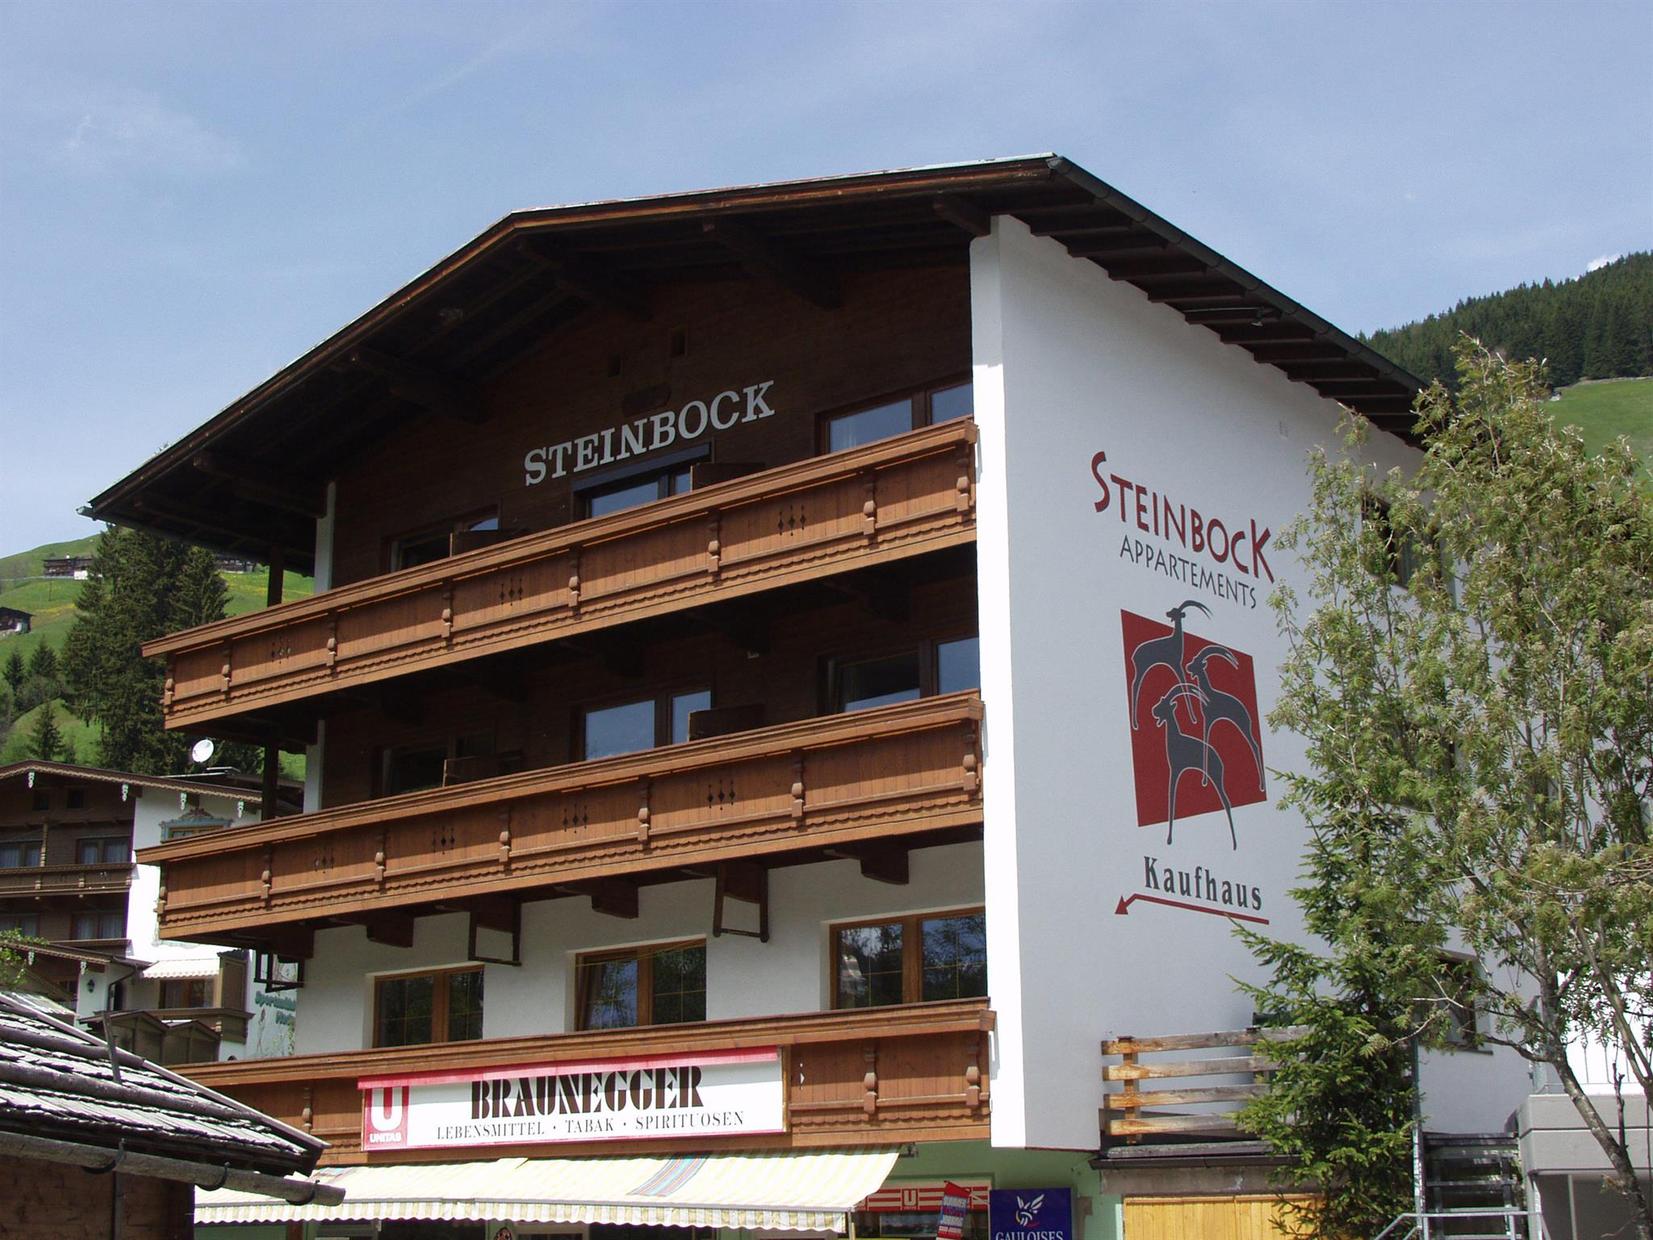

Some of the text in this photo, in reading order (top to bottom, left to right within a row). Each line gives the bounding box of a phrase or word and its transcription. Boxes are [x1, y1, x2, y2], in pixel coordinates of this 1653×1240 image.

[524, 380, 775, 487] STEINBOCK
[1091, 451, 1275, 584] STEINBOCK
[1119, 534, 1257, 609] APPARTEMENTS
[1143, 856, 1262, 911] Kaufhaus
[371, 1087, 403, 1132] U
[471, 1066, 704, 1120] BRAUNEGGER
[437, 1111, 744, 1141] LEBENSMITTEL TABAK SPIRITUOSEN
